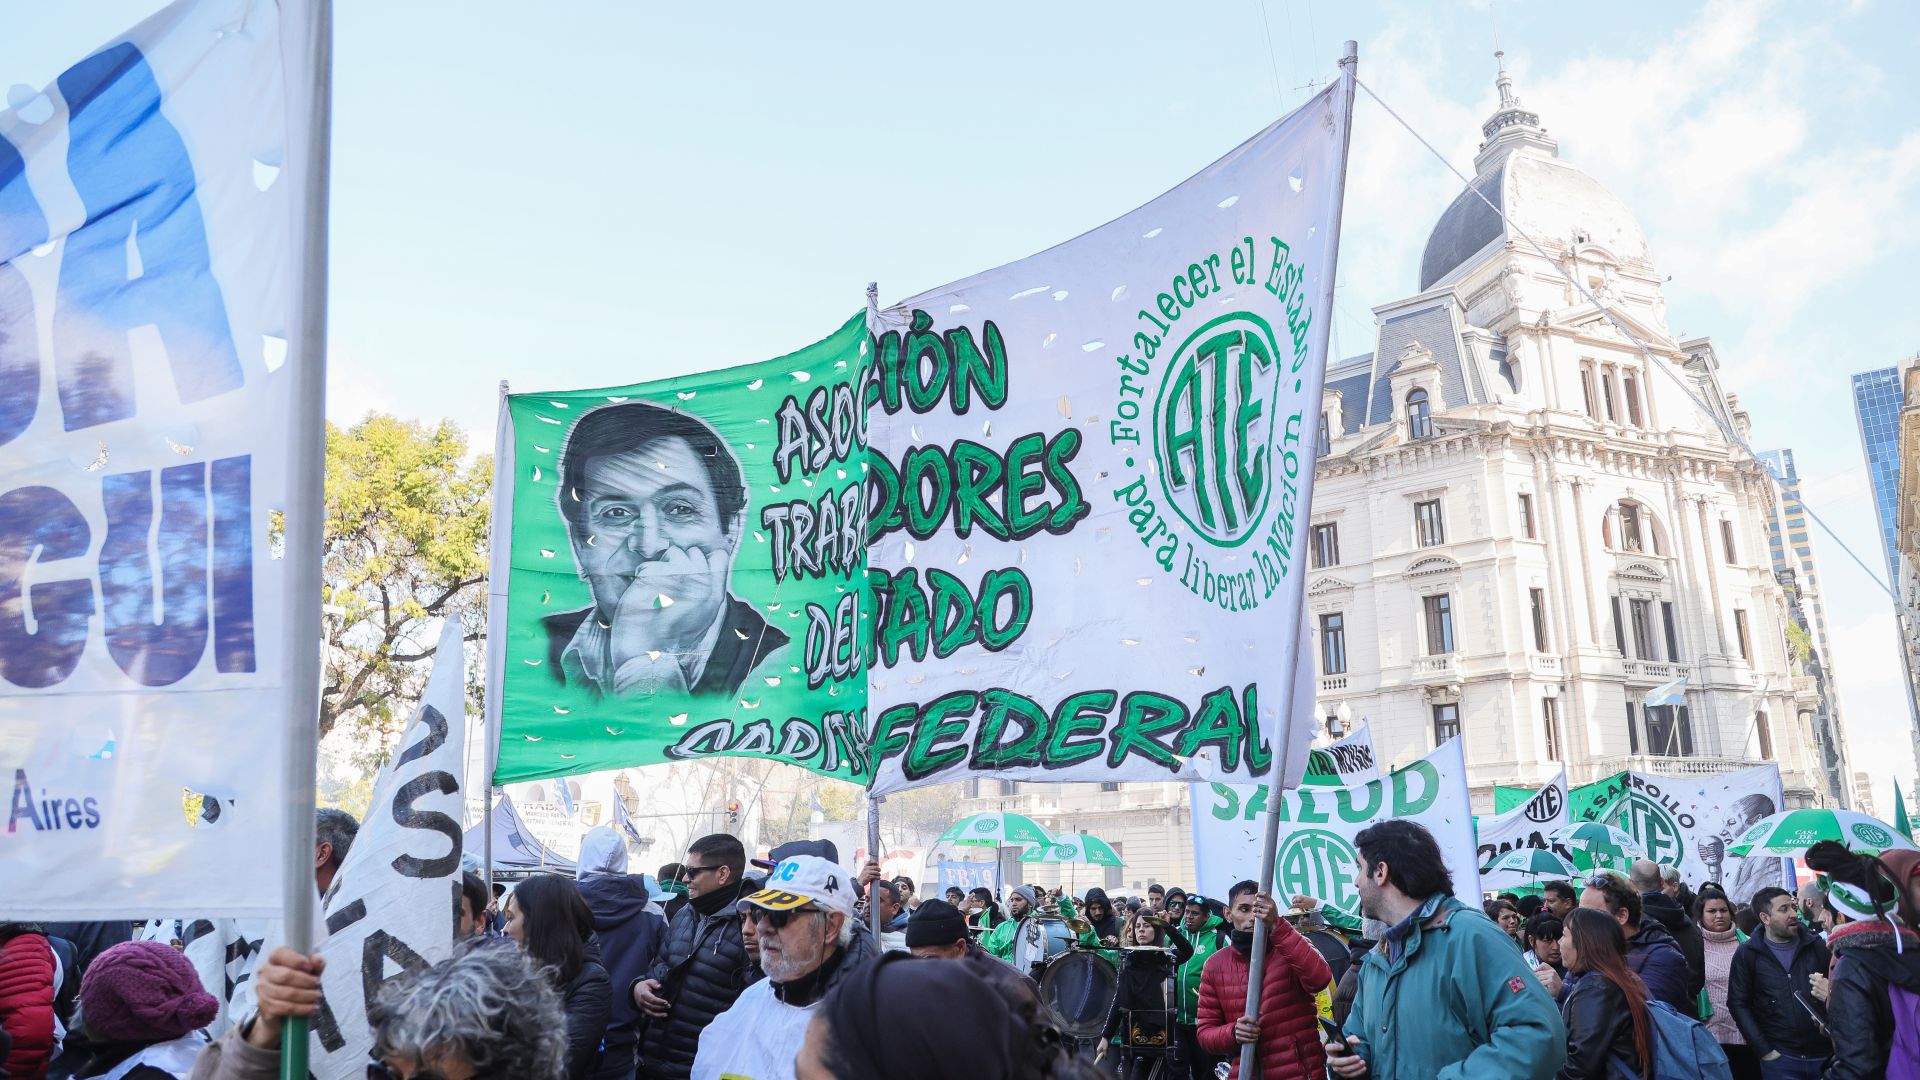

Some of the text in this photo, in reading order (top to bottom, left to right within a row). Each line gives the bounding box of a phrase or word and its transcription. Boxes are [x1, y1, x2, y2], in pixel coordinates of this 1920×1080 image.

[1110, 251, 1220, 447] Fortalecer
[1231, 236, 1256, 285] el
[1163, 328, 1274, 533] ATE
[1113, 474, 1180, 573] para
[1179, 541, 1256, 613] liberar
[866, 682, 1273, 782] FEDERAL
[8, 768, 101, 832] Aires
[1578, 772, 1696, 829] ESARROLLO
